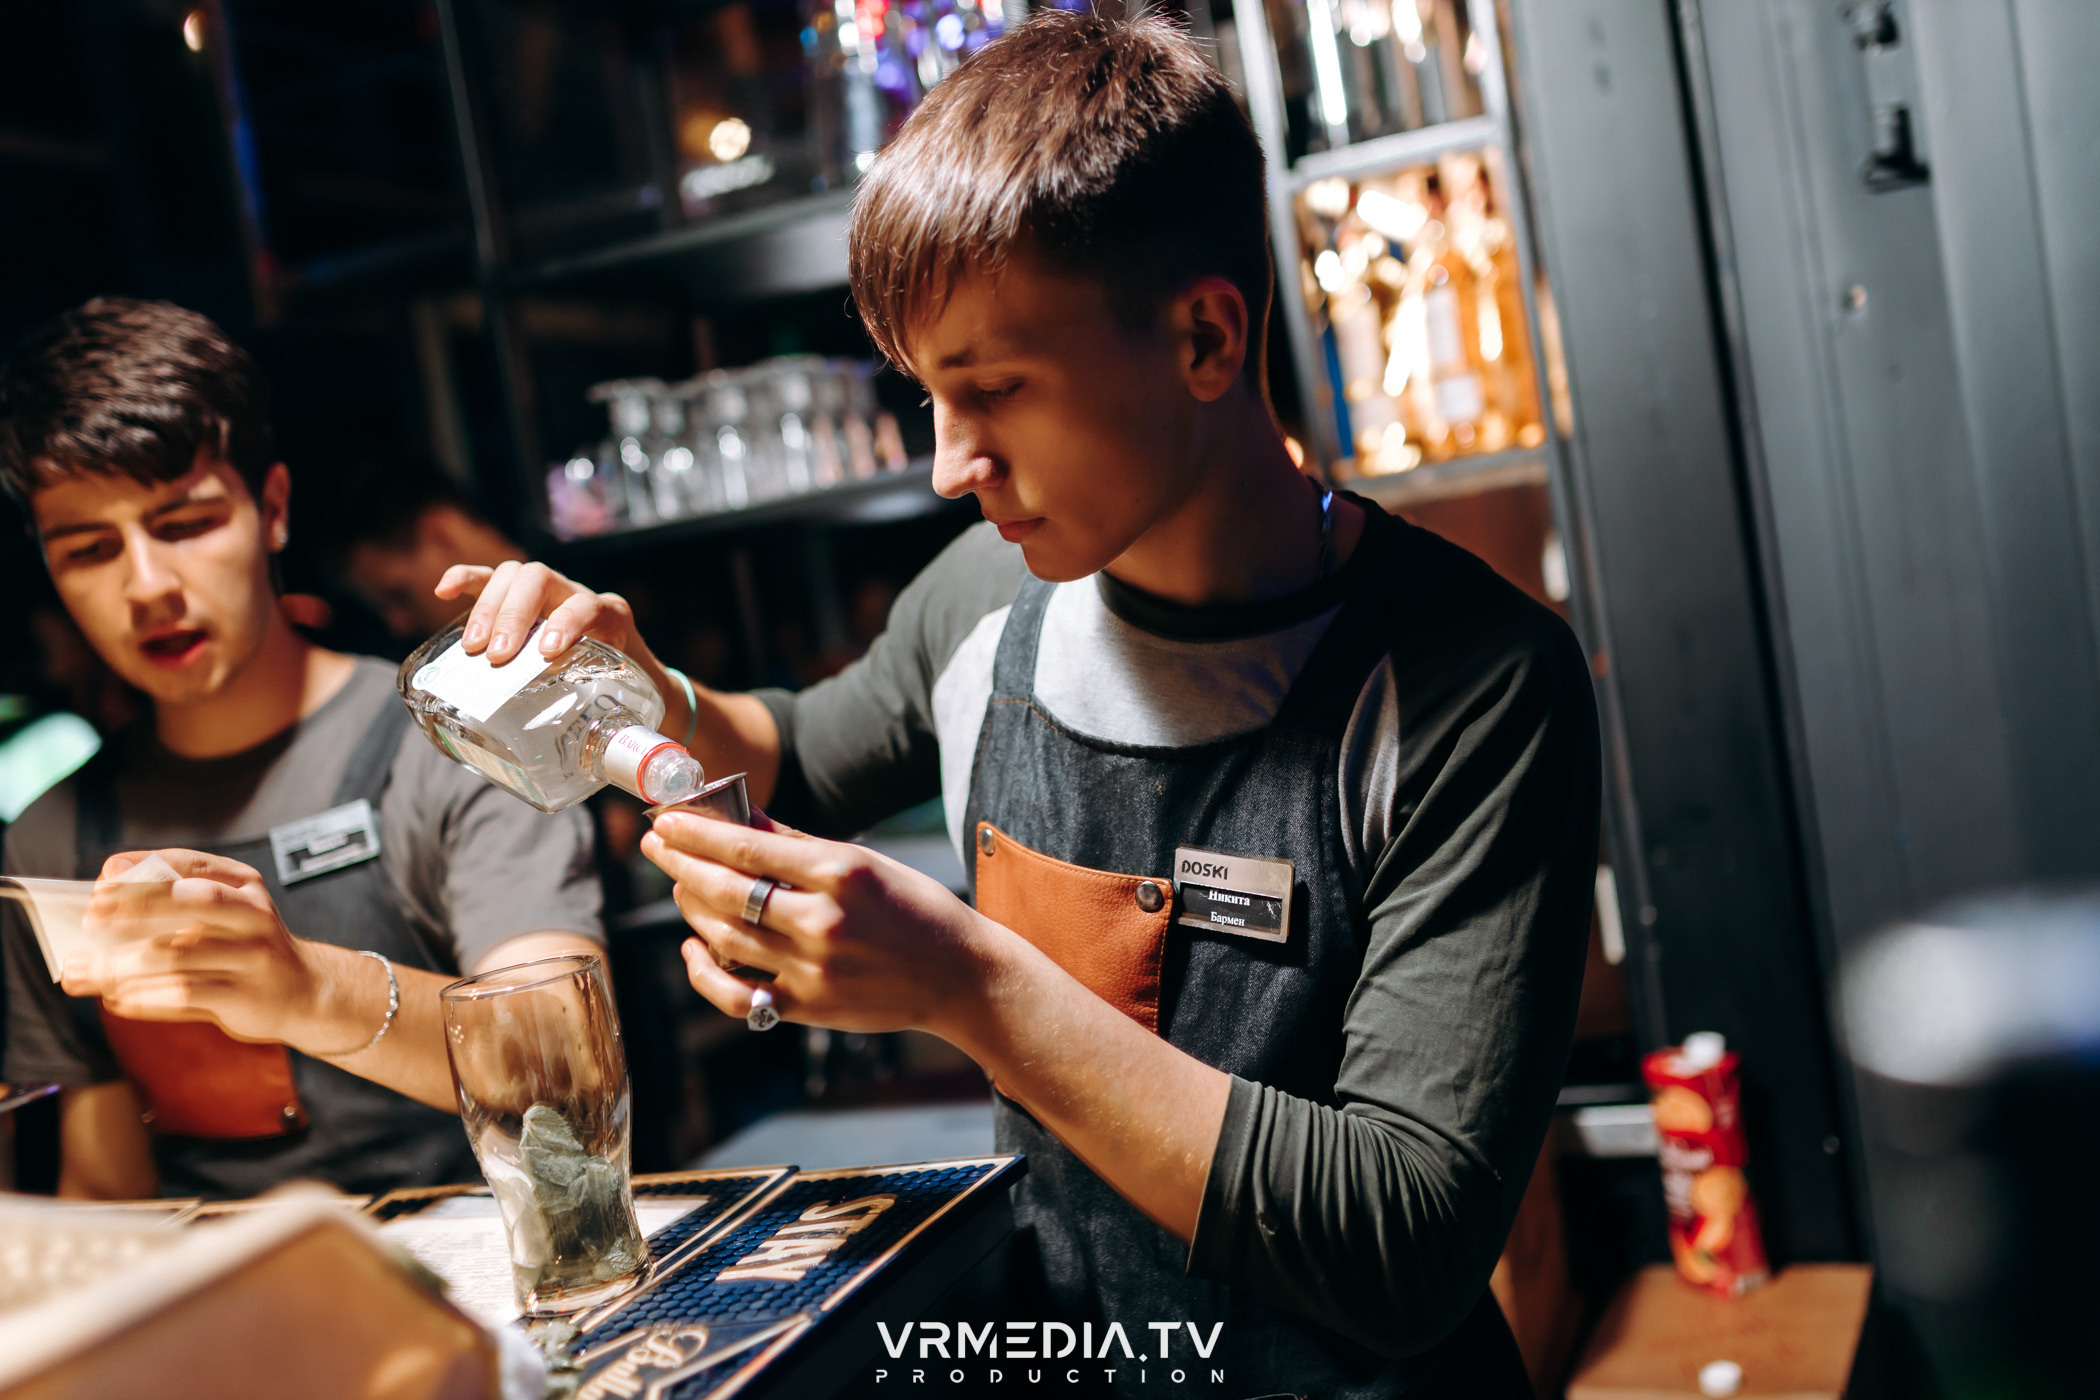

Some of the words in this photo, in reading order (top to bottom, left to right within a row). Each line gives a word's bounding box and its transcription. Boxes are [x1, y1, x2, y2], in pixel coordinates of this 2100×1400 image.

[1181, 859, 1228, 880] DOSKI
[1208, 889, 1250, 906] Никита
[1210, 911, 1245, 927] Бармен
[715, 1193, 898, 1281] STAY
